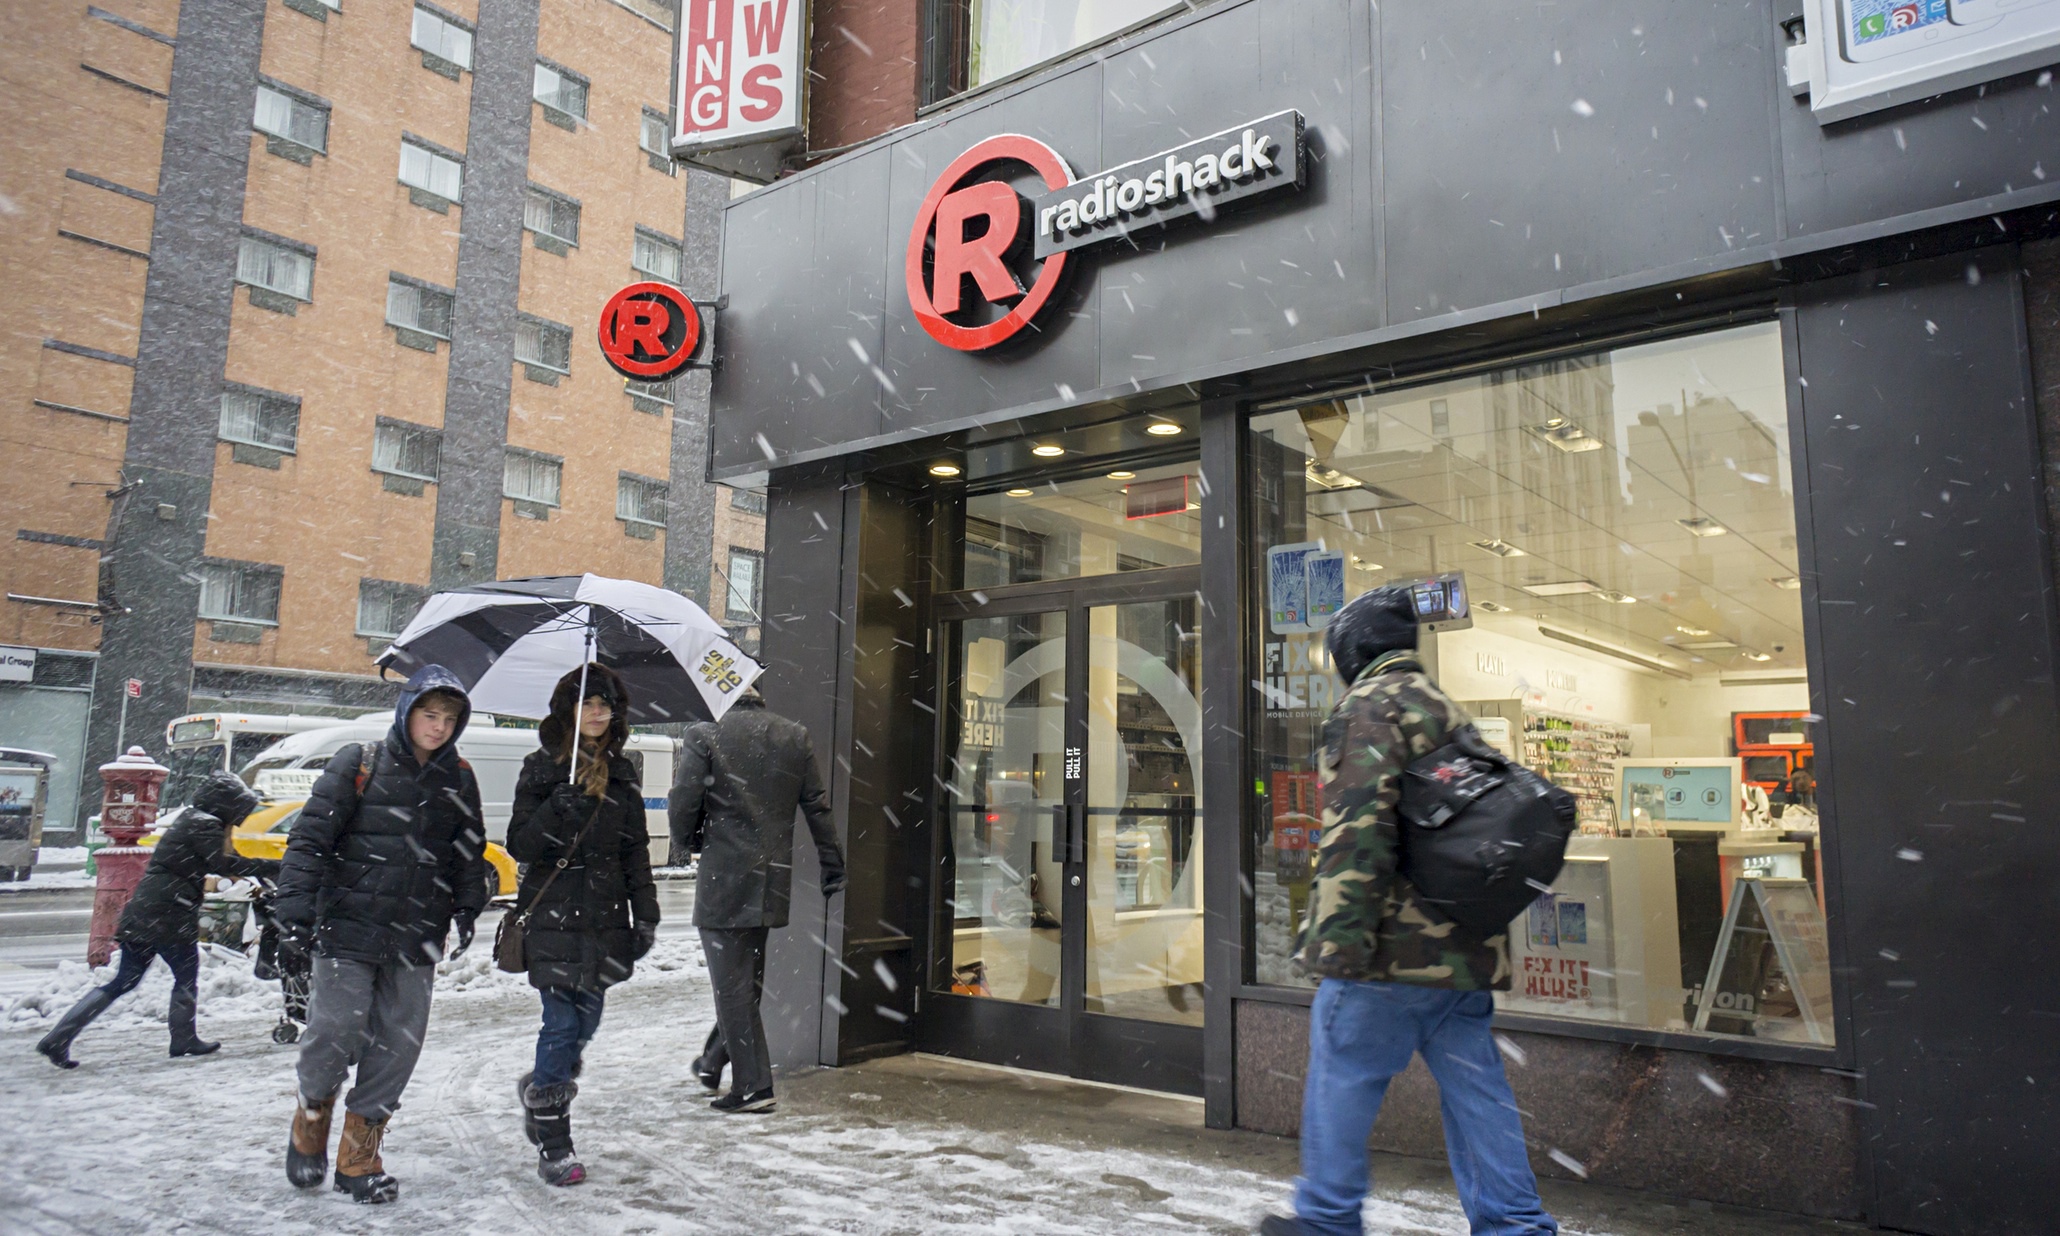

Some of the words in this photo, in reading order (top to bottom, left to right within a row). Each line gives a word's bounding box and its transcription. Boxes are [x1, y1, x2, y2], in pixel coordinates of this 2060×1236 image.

[1040, 128, 1274, 237] radioshack
[7, 656, 34, 668] Group
[1266, 640, 1313, 674] FIX
[1266, 711, 1294, 719] MOBILE
[1066, 747, 1074, 757] IT
[1073, 747, 1081, 756] IT
[1066, 757, 1074, 780] PULL
[1073, 757, 1081, 779] PULL
